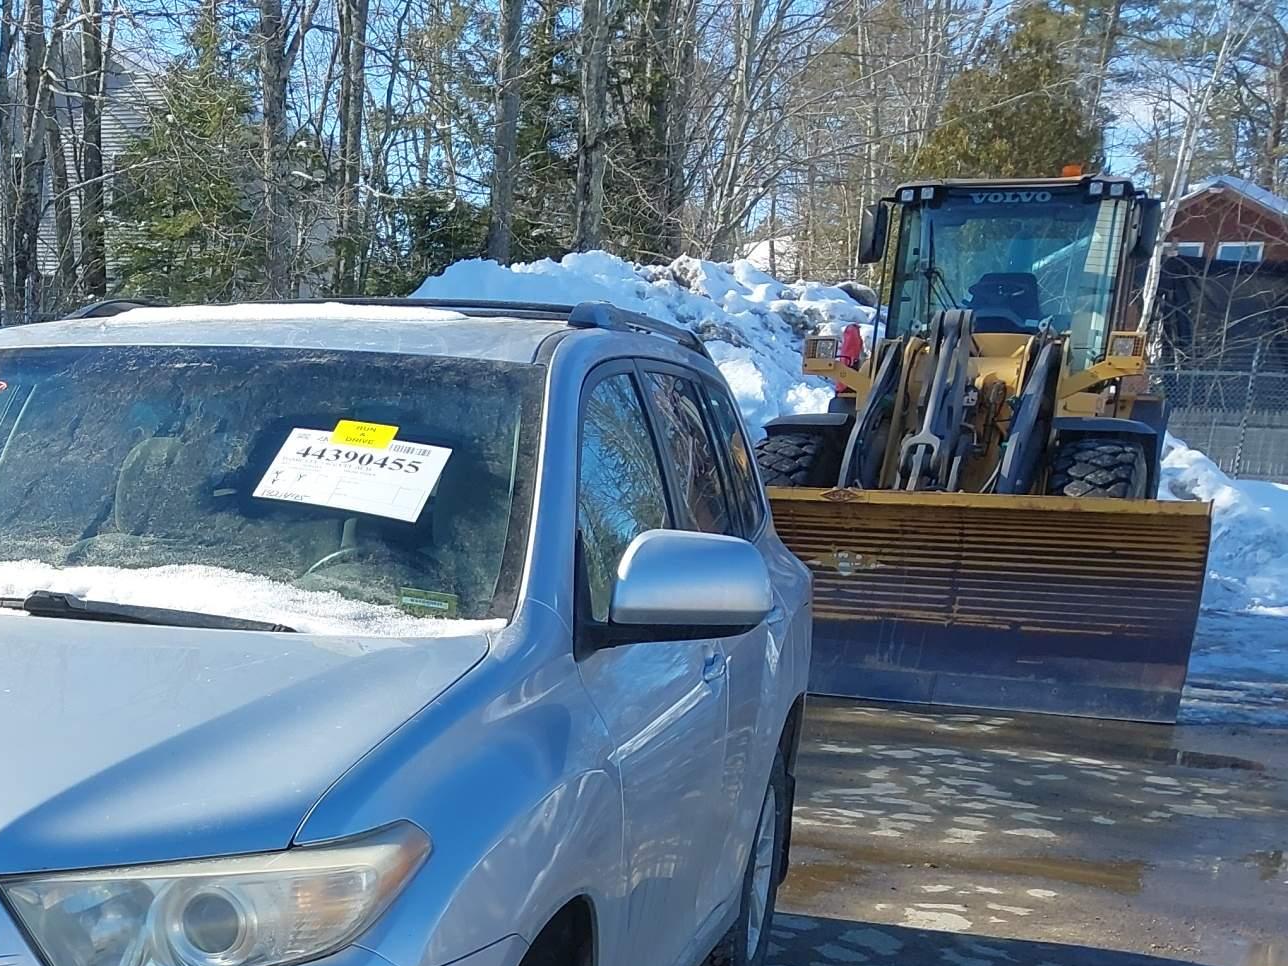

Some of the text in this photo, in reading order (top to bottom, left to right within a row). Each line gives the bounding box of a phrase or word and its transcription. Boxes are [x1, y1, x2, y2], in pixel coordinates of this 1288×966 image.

[969, 191, 1052, 204] VOLVO
[345, 436, 376, 445] DRIVE
[296, 445, 424, 474] 44390455
